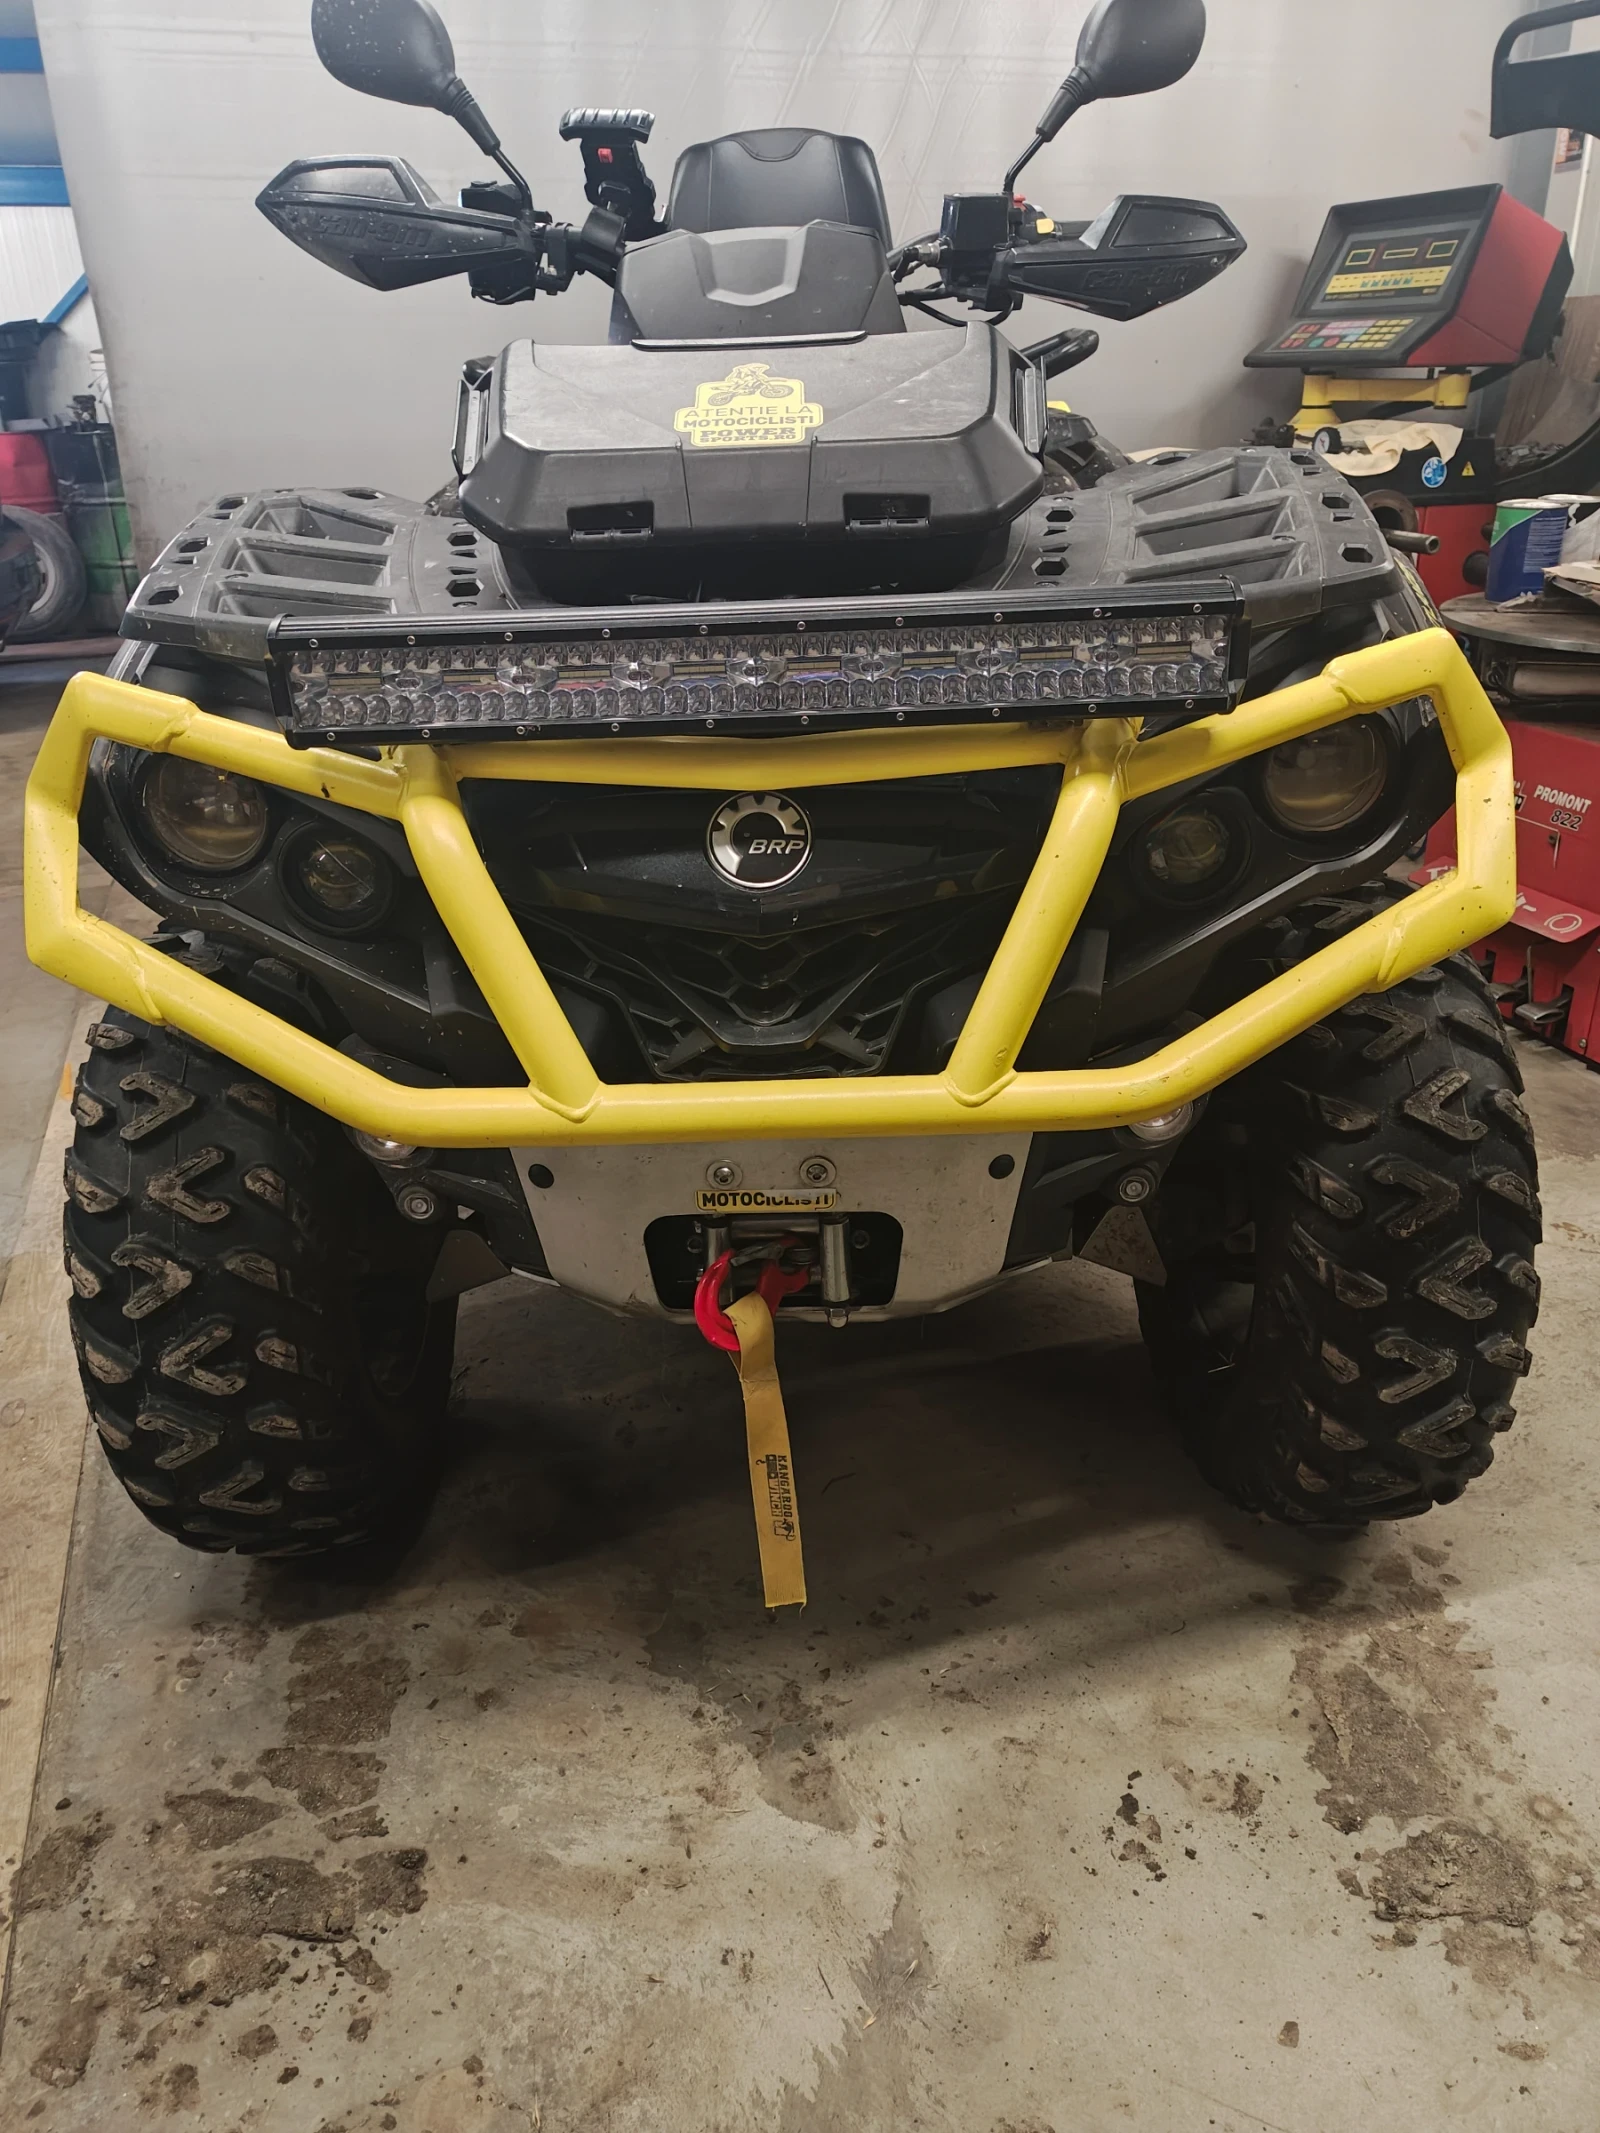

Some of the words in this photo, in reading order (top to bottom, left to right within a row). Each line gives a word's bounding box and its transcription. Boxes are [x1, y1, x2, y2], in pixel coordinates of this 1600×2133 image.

[683, 405, 778, 419] ATENTIE
[785, 404, 813, 415] LA
[683, 415, 814, 429] MOTOCICLISTI
[699, 427, 796, 438] POWER
[699, 434, 796, 443] SPORTS.RO
[1533, 784, 1592, 814] PROMONT
[1550, 808, 1582, 831] 822
[748, 839, 805, 854] BRP
[778, 1455, 793, 1518] KANGAROO
